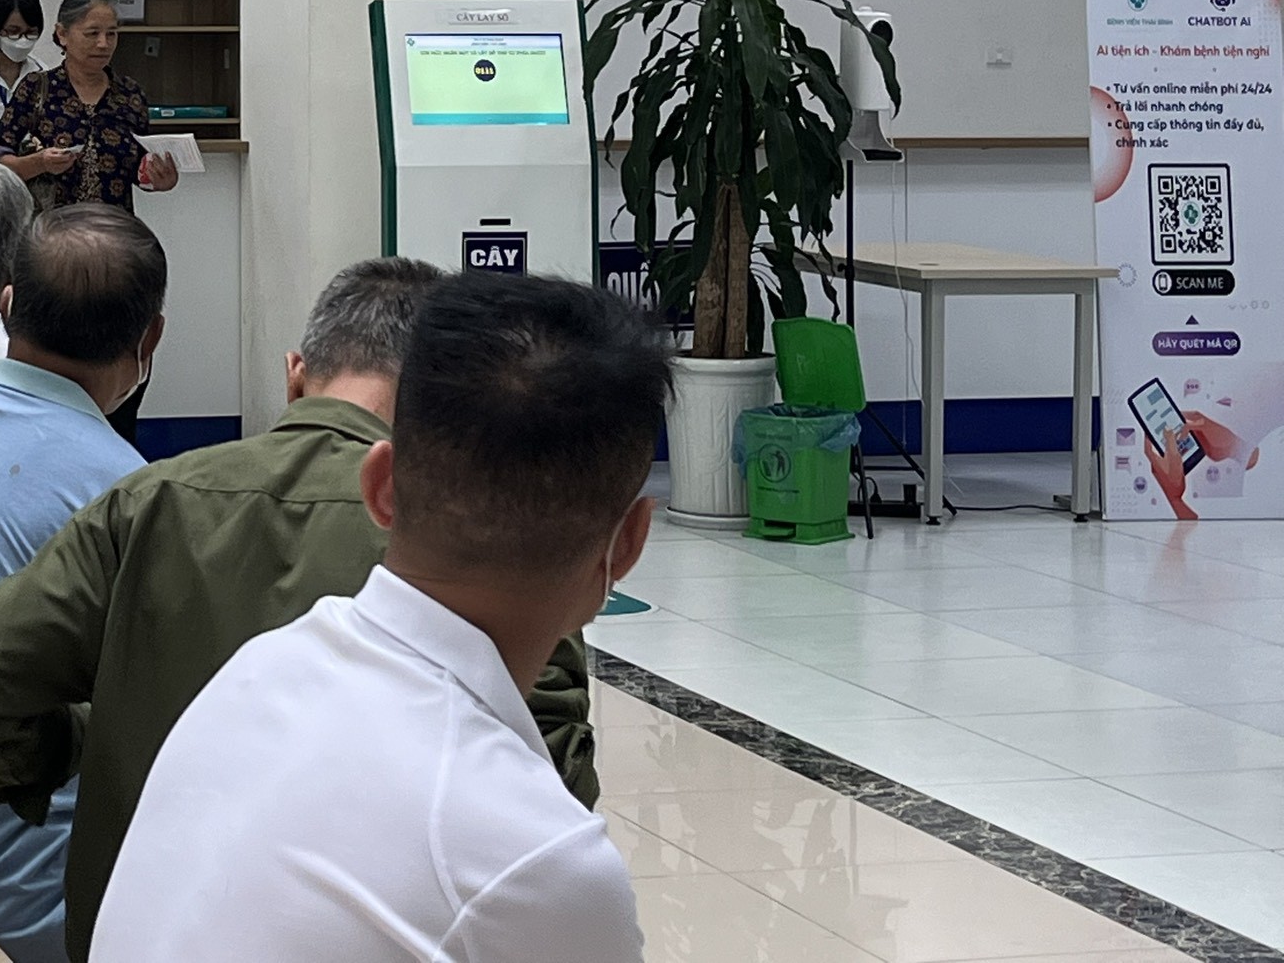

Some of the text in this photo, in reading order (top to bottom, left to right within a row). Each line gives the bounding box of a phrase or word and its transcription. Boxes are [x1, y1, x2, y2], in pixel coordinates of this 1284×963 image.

[1187, 16, 1251, 27] CHATBOT AI
[1111, 44, 1132, 58] tiện
[1134, 44, 1150, 57] ích
[1160, 44, 1191, 57] Khám
[1194, 44, 1220, 59] bệnh
[1223, 44, 1244, 59] tiện
[1130, 81, 1150, 95] vấn
[1153, 82, 1187, 95] online
[1190, 81, 1218, 95] miễn
[1220, 82, 1239, 97] phí
[1241, 82, 1273, 96] 24/24
[1114, 99, 1132, 112] Trả
[1150, 101, 1186, 112] nhanh
[1188, 100, 1224, 114] chóng
[1115, 120, 1145, 132] Cung
[1147, 118, 1167, 133] cấp
[1169, 118, 1203, 133] thông
[1206, 118, 1221, 130] tin
[1115, 137, 1169, 149] chính xác
[470, 246, 518, 267] CÂY
[1176, 277, 1224, 290] SCAN ME
[1223, 338, 1238, 350] QR
